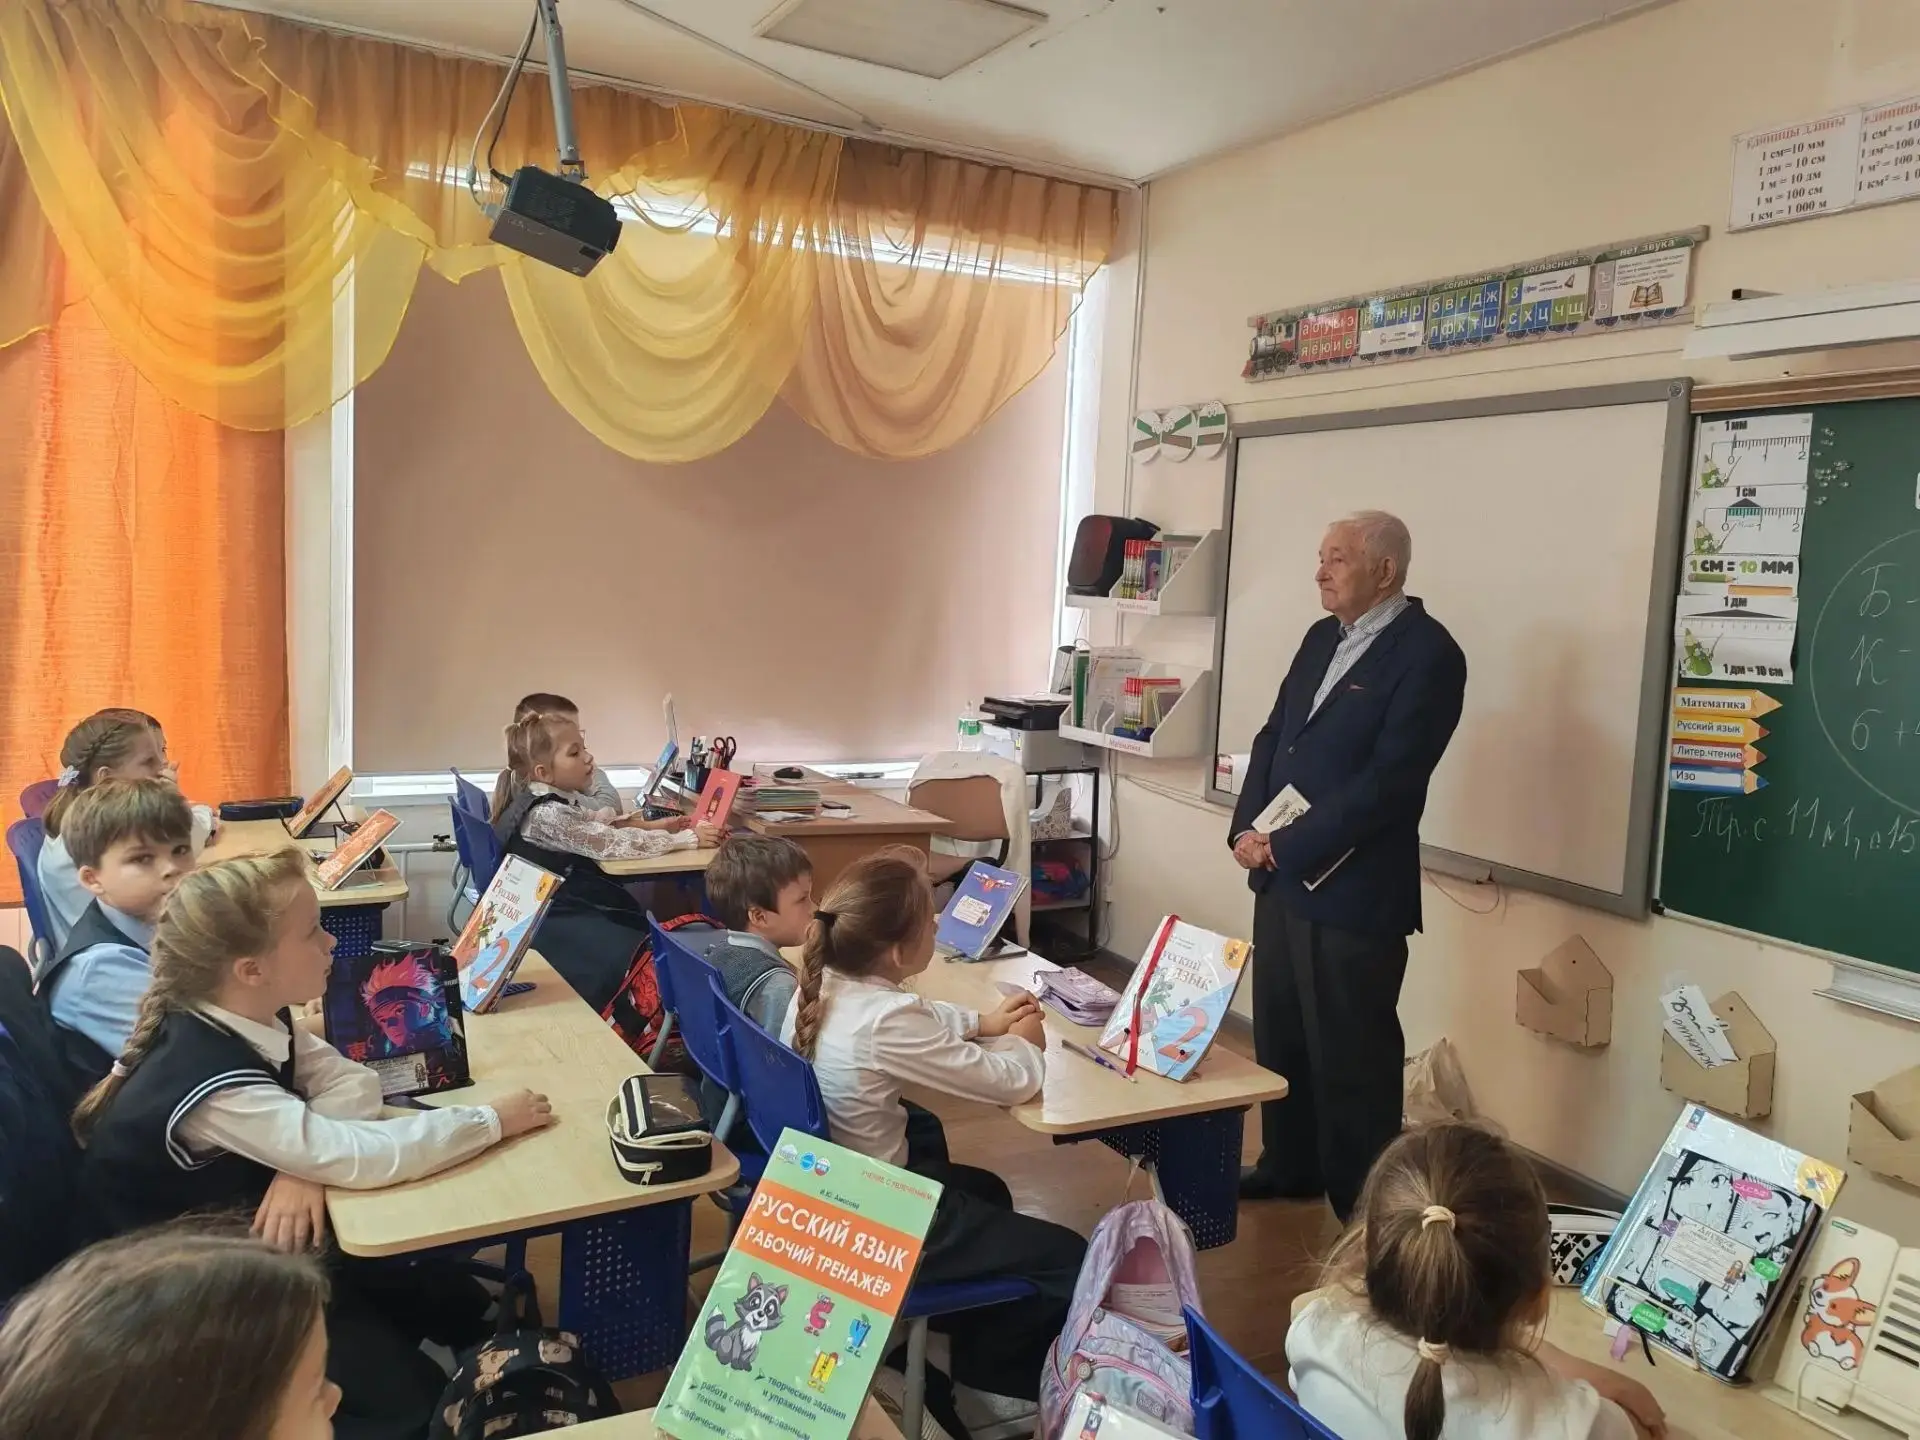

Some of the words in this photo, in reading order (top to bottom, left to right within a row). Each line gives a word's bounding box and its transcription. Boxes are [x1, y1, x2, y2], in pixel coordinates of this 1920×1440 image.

[1747, 128, 1800, 149] ЕДИНИЦЫ
[1802, 117, 1846, 136] ДЛИНЫ
[1807, 140, 1825, 151] мм
[1796, 157, 1808, 168] 10
[1811, 155, 1825, 165] см
[1894, 154, 1913, 166] 100
[1791, 173, 1803, 184] 10
[1787, 188, 1805, 201] 100
[1808, 186, 1823, 196] см
[1758, 211, 1773, 221] км
[1796, 201, 1815, 213] 000
[1725, 421, 1730, 431] 1
[1798, 451, 1806, 460] 2
[1736, 487, 1741, 497] 1
[1792, 523, 1799, 532] 2
[1690, 560, 1697, 572] 1
[1739, 560, 1757, 573] 10
[1724, 596, 1729, 607] 1
[1723, 664, 1728, 674] 1
[1755, 665, 1767, 676] 10
[1681, 696, 1746, 711] Математика
[1676, 719, 1714, 733] Русский
[1716, 723, 1741, 734] язык
[1676, 745, 1743, 760] Литер.чтение
[1676, 770, 1696, 781] Изо
[470, 936, 510, 991] 2
[1158, 1006, 1209, 1064] 2
[752, 1191, 851, 1249] РУССКИЙ
[850, 1231, 910, 1273] ЯЗЫК
[744, 1226, 815, 1269] РАБОЧИЙ
[815, 1253, 892, 1298] ТРЕНАЖЁР
[700, 1381, 728, 1400] работа
[768, 1375, 813, 1405] творческие
[813, 1397, 847, 1421] задания
[696, 1391, 726, 1414] текстом
[768, 1390, 817, 1422] упражнения
